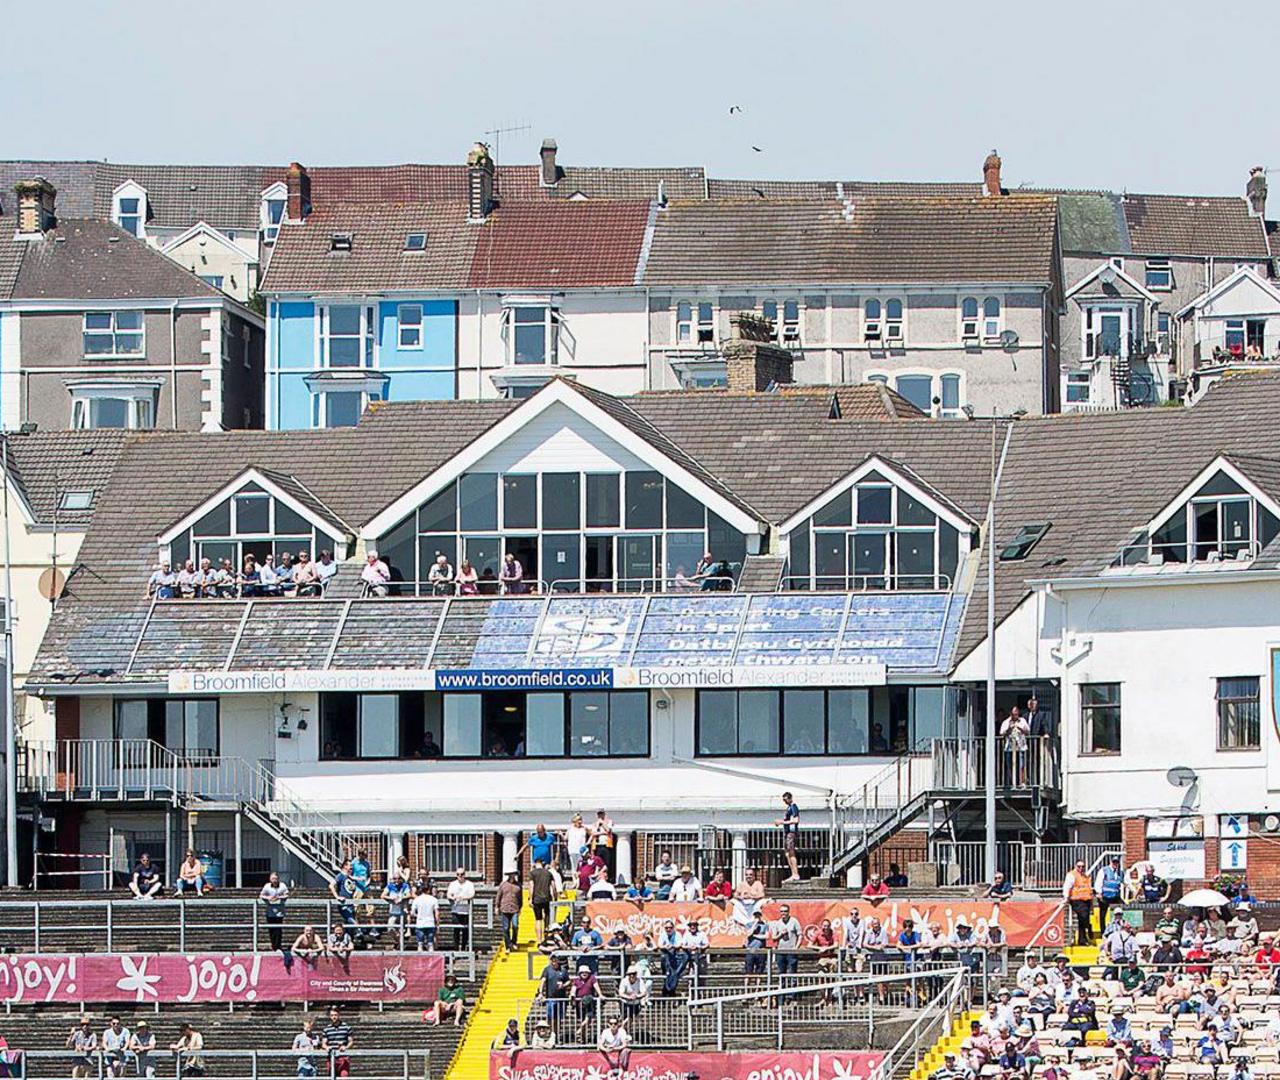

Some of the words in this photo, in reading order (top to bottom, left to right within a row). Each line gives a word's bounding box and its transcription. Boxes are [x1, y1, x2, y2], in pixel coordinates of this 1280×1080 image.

[193, 673, 286, 690] Broomfield
[291, 674, 375, 689] Alexander
[438, 670, 610, 687] www.broomfield.co.uk
[638, 668, 733, 685] Broomfield
[739, 668, 824, 685] Alexander
[176, 954, 261, 1001] joio!
